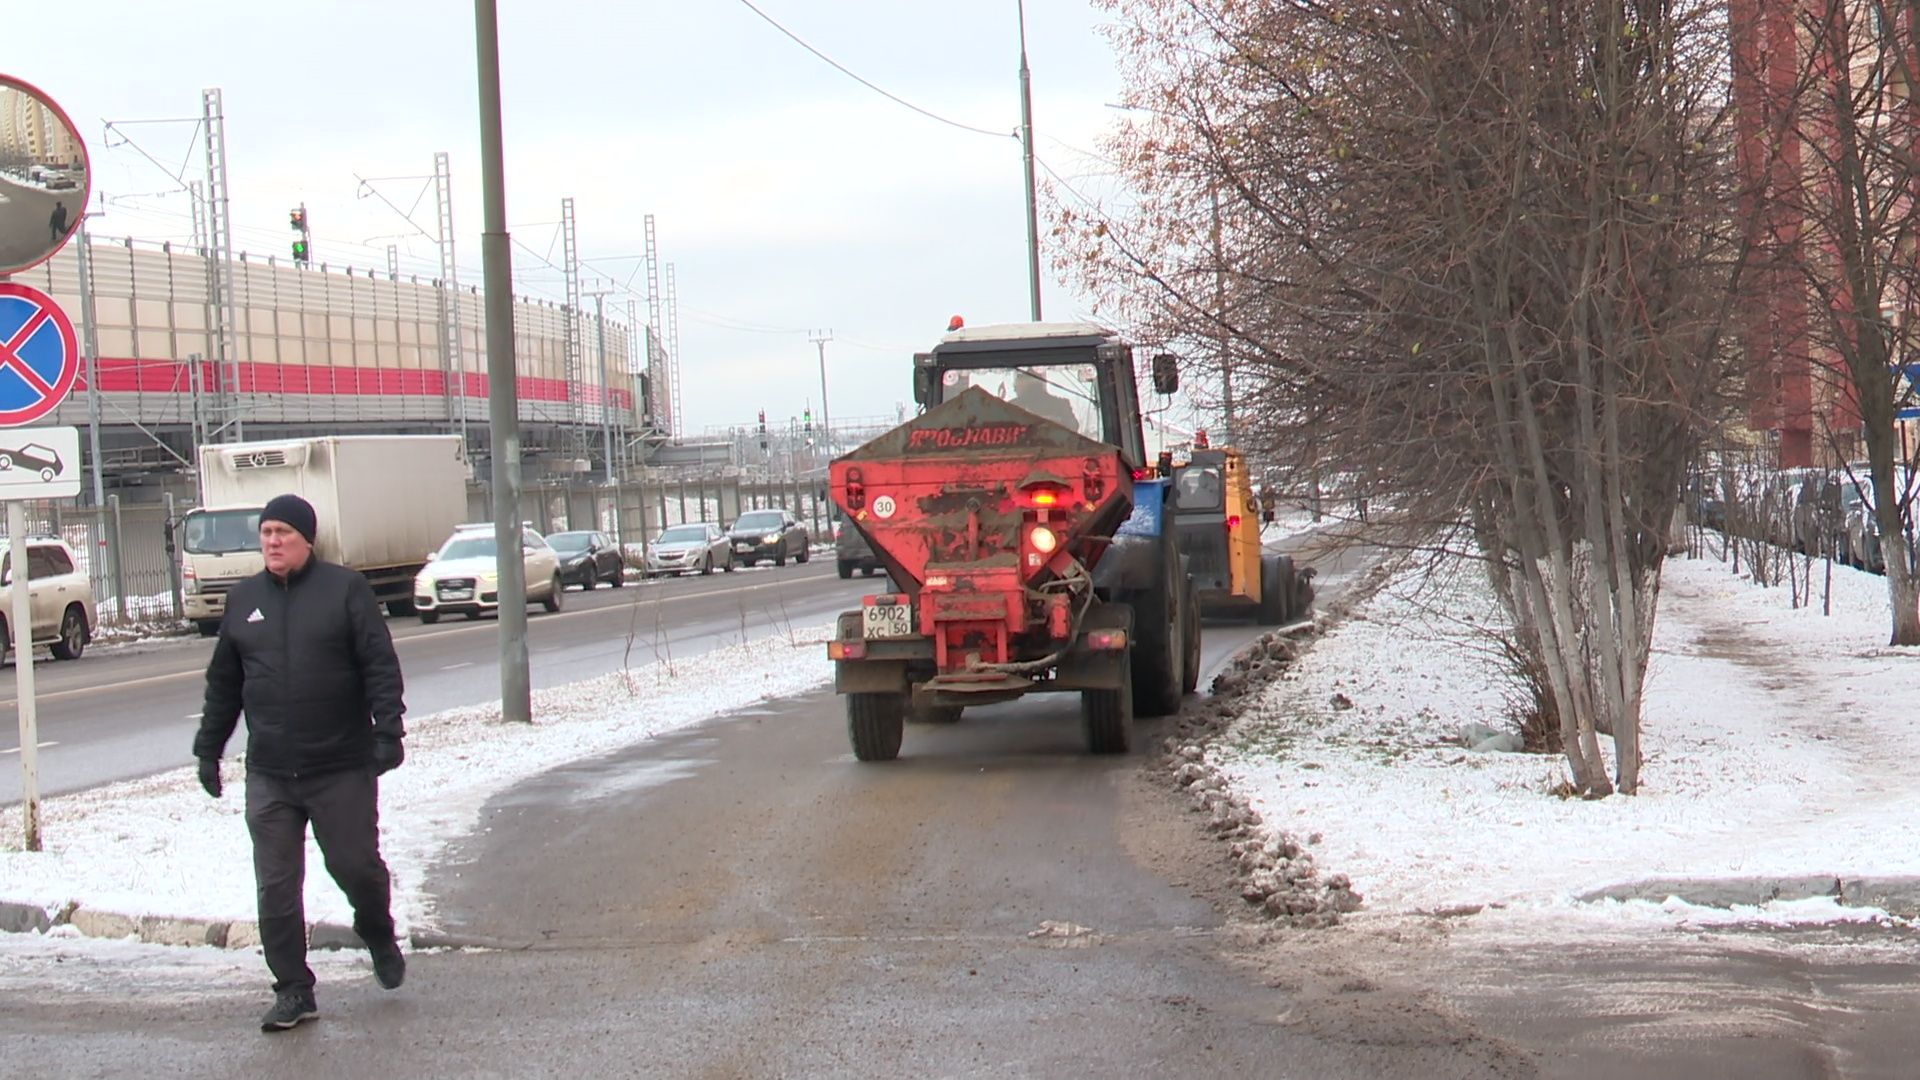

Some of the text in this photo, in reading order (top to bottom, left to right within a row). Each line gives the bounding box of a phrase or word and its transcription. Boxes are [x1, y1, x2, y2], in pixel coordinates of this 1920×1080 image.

[877, 501, 892, 513] 30
[868, 606, 905, 621] 6902
[893, 622, 908, 634] 50
